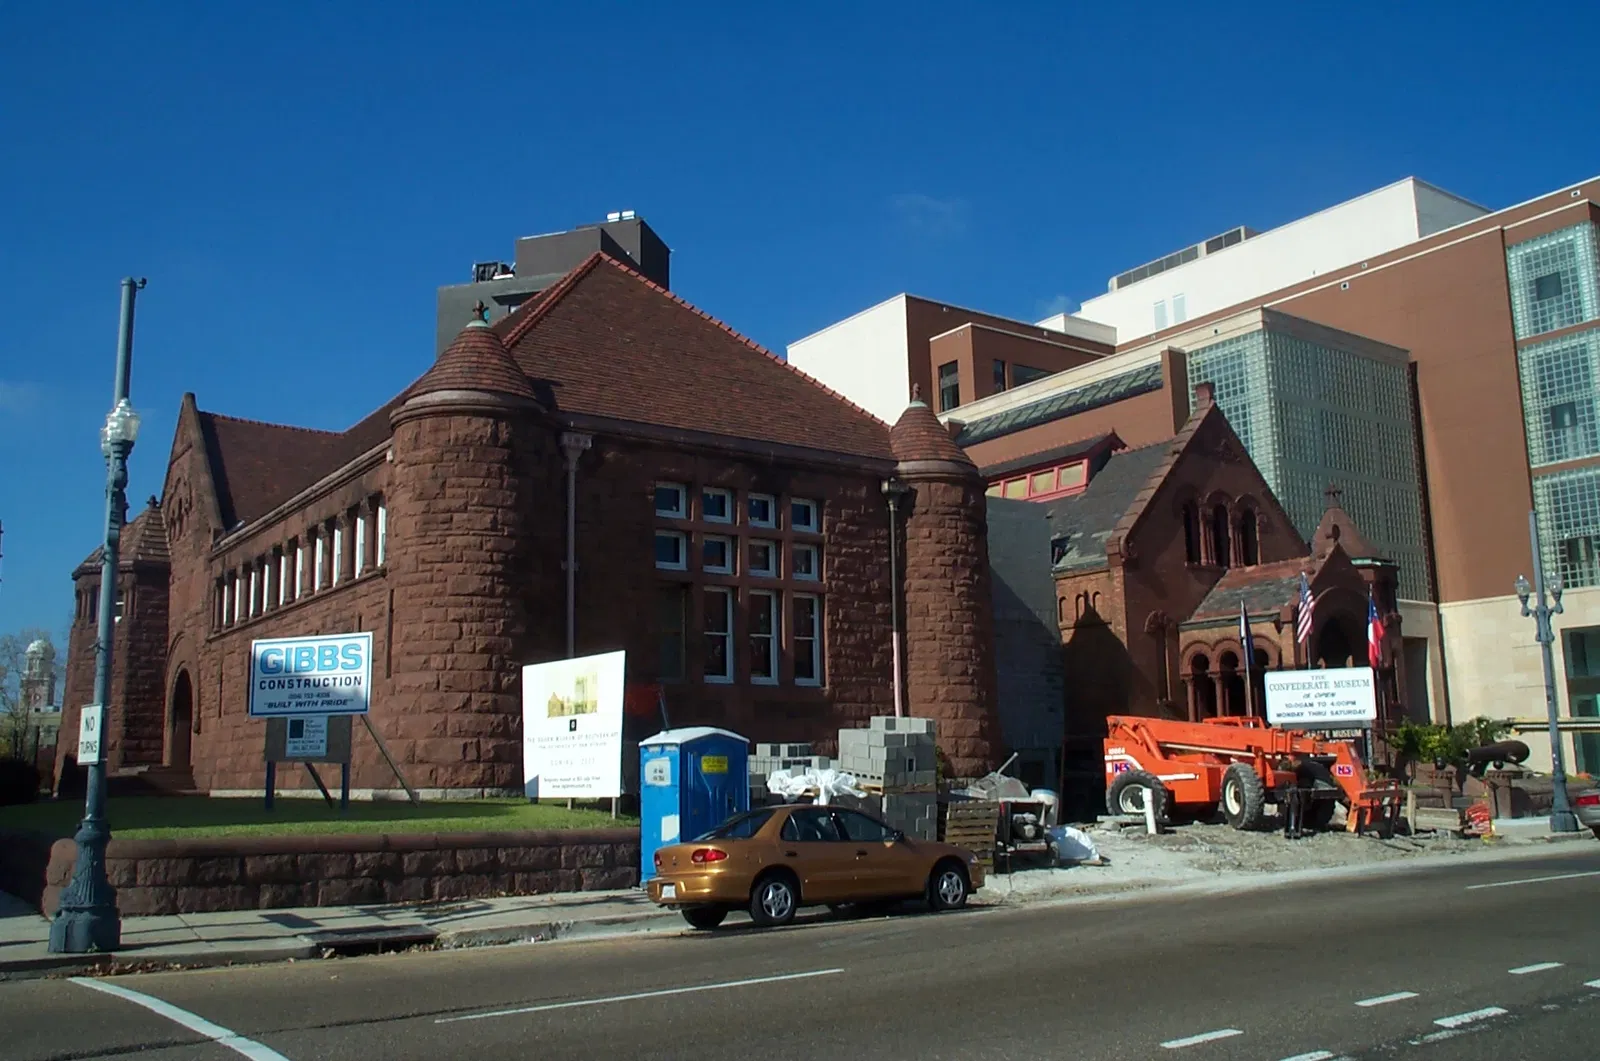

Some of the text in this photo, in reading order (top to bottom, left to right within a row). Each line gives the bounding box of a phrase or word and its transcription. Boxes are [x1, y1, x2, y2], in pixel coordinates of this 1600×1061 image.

[260, 643, 363, 675] GIBBS
[259, 676, 362, 690] CONSTRUCTION
[1268, 679, 1371, 692] CONFEDERATE MUSEUM
[294, 700, 319, 708] WITH
[1284, 701, 1315, 709] 10:00AM
[84, 715, 96, 733] NO
[1331, 728, 1363, 738] MUSEUM
[80, 740, 98, 754] TURNS
